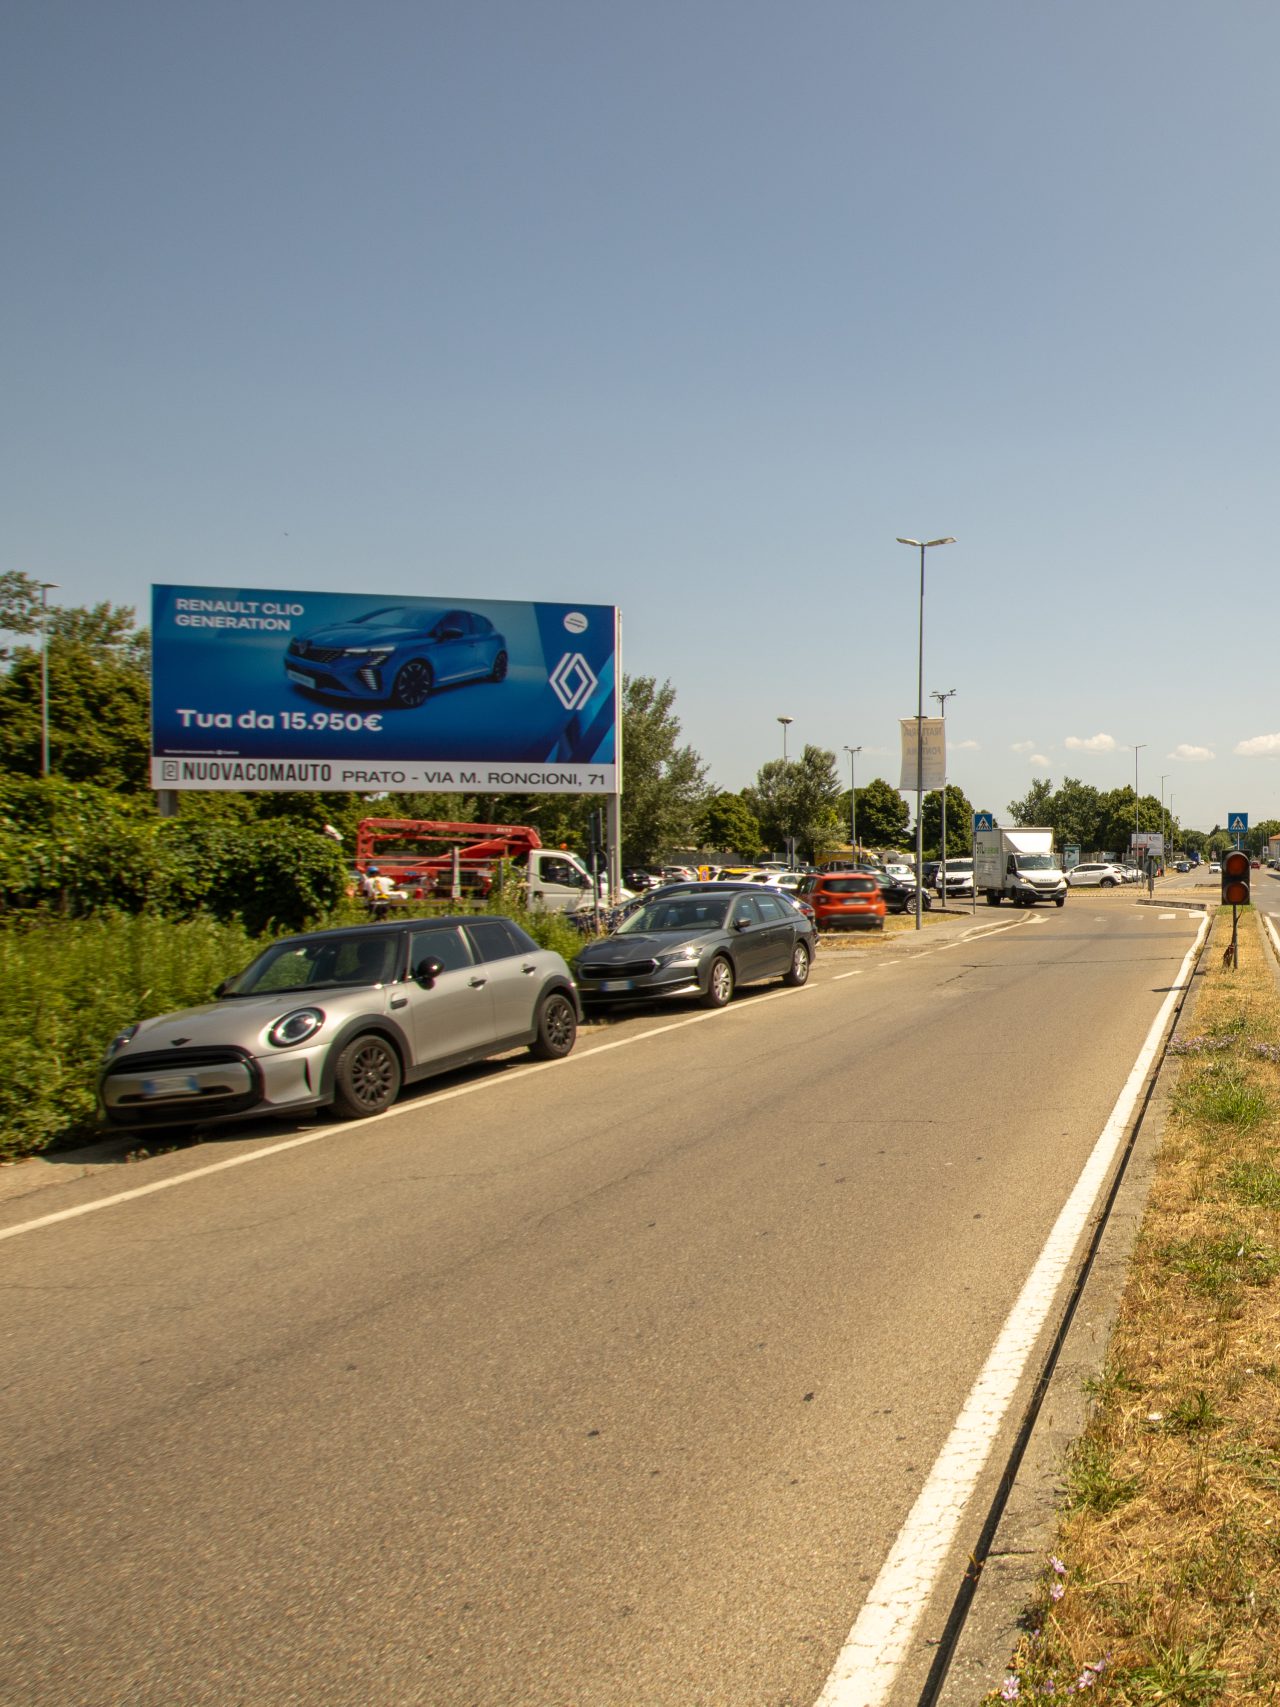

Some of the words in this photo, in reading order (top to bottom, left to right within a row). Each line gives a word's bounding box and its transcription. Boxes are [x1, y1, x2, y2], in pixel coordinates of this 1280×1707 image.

[176, 598, 259, 614] RENAULT
[262, 602, 304, 616] CLIO
[175, 614, 291, 631] GENERATION
[176, 709, 232, 728] Tua
[238, 710, 275, 729] da
[280, 711, 383, 731] 15.950€
[183, 762, 332, 782] NUOVACOMAUTO
[342, 770, 406, 783] PRATO
[424, 771, 454, 784] VIA
[460, 772, 481, 784] M.
[488, 772, 582, 787] RONCIONI,
[588, 774, 606, 785] 71
